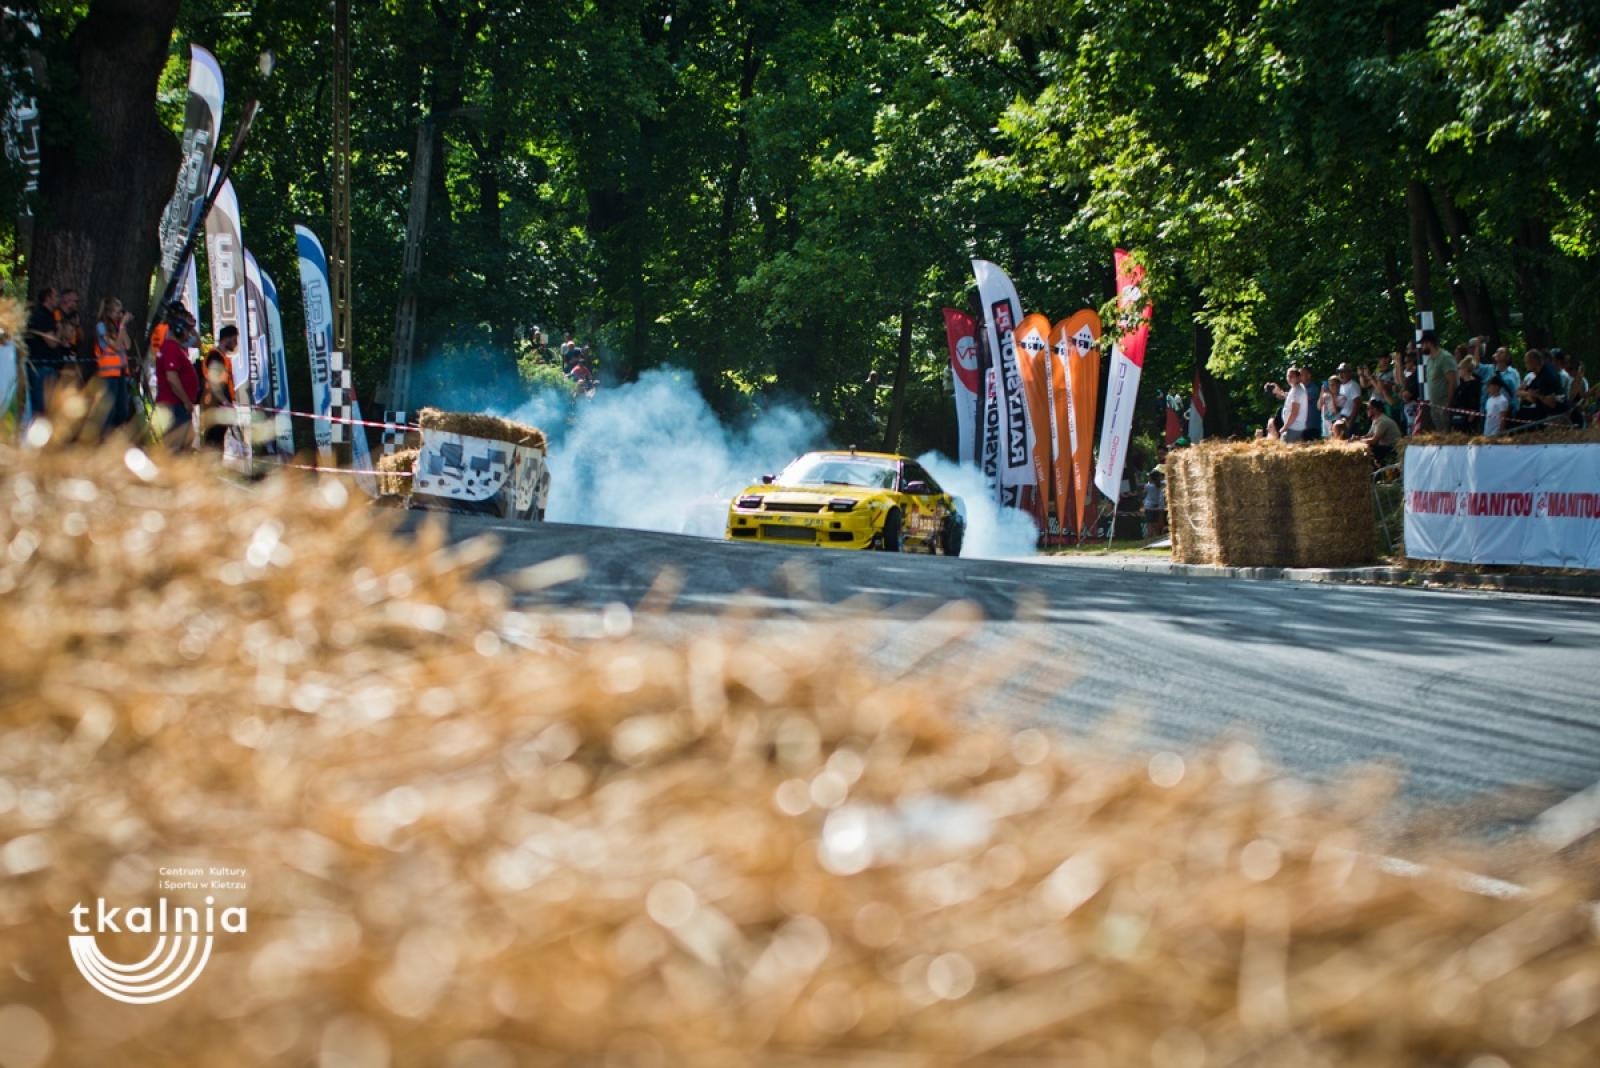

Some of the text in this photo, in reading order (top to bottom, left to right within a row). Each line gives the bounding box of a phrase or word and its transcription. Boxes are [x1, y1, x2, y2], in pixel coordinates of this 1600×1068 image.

[1412, 490, 1600, 518] MANITOU MANITOU MANITOU
